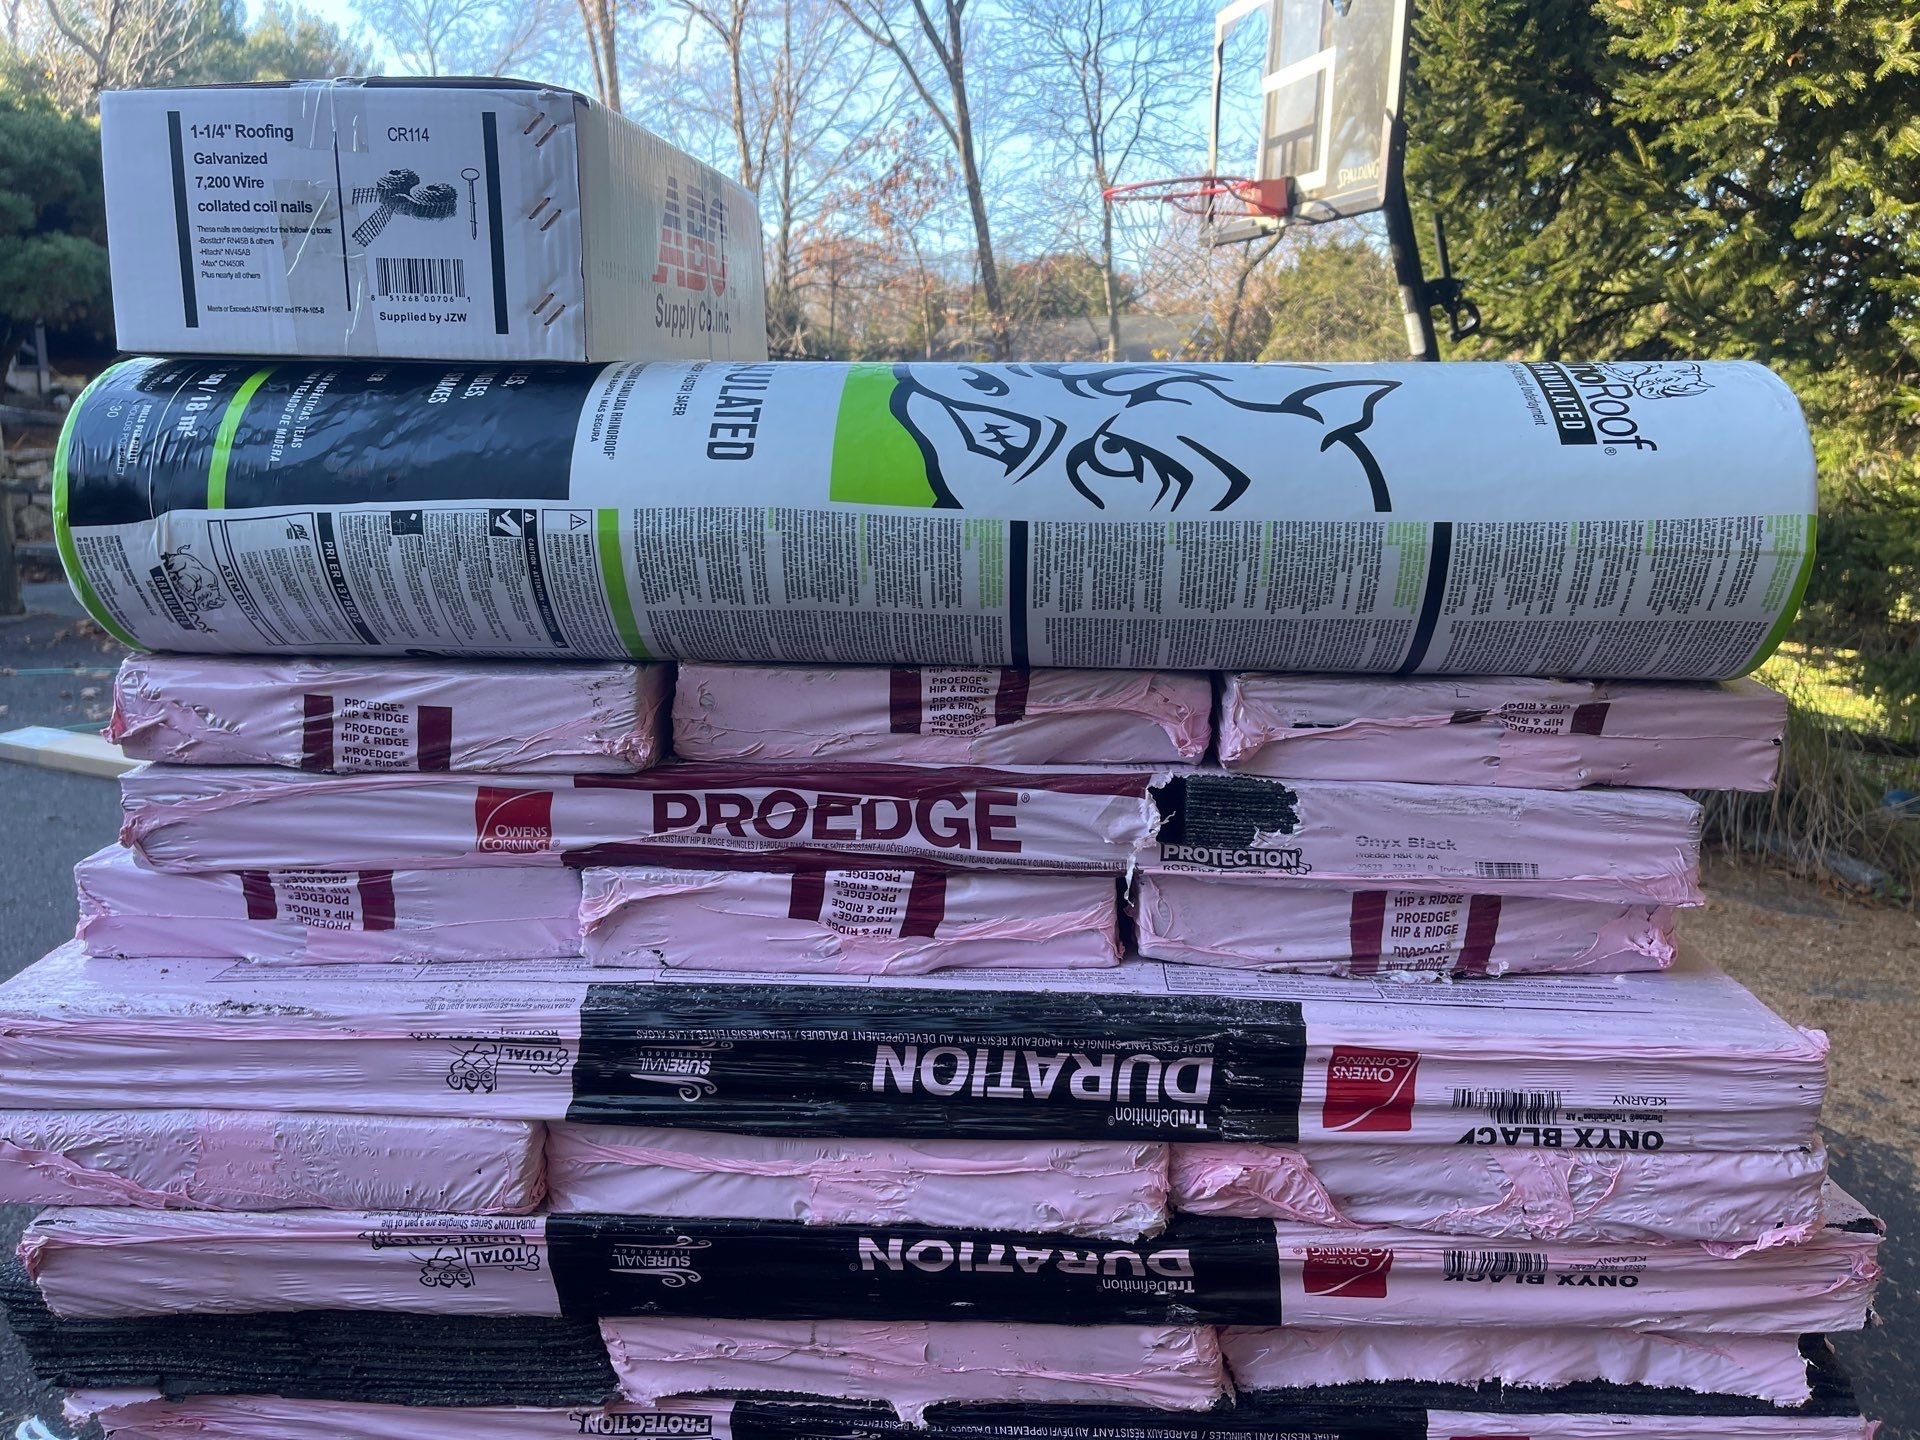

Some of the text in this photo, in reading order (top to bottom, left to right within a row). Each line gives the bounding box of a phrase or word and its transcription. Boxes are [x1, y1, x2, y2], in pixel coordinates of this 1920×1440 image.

[191, 124, 293, 141] 1-1/4" Roofing
[388, 127, 429, 142] CR114
[194, 152, 267, 164] Galvanized
[1338, 158, 1380, 189] SPALDING
[196, 176, 264, 190] 7,200 Wire
[198, 200, 313, 213] collated coil nails
[242, 226, 269, 234] designed
[652, 176, 728, 297] ABC
[380, 312, 467, 324] Supplied by JZW
[656, 293, 696, 338] Supply
[681, 374, 699, 392] FASTER
[186, 395, 212, 411] 18
[672, 395, 690, 416] SAFER
[1522, 386, 1548, 426] Underlayment
[106, 405, 122, 418] 30
[706, 362, 778, 460] NULATED
[118, 404, 140, 449] ROLLOS POR
[132, 404, 152, 438] ROLLS PER
[269, 385, 310, 463] TEJADOS DE MADERA
[591, 399, 609, 443] MÁS SEGURA
[291, 425, 306, 448] TEJAS
[528, 538, 544, 601] CAUTION ATTENTION
[324, 541, 361, 624] PRI ER 1378E02
[154, 575, 190, 625] GRANULATED
[221, 564, 259, 621] ASTM D1970
[960, 686, 990, 694] RIDGE
[340, 709, 358, 718] HIP
[374, 712, 409, 723] RIDGE
[341, 733, 409, 746] HIP & RIDGE
[342, 755, 360, 764] HIP
[495, 824, 548, 838] OWENS
[481, 837, 547, 850] CORNING
[658, 835, 689, 844] RESISTANT
[691, 836, 700, 844] HIP
[701, 837, 706, 845] &
[707, 836, 725, 846] RIDGE
[726, 838, 754, 849] SHINGLES
[759, 841, 790, 850] BARDEAUX
[886, 843, 937, 857] DÉVELOPPEMENT
[937, 850, 964, 862] D'ALGUES
[968, 855, 985, 864] TEJAS
[995, 857, 1026, 866] CABALLETE
[1355, 835, 1458, 851] Onyx Black
[1164, 845, 1296, 867] PROTECTION
[833, 880, 867, 890] RIDGE
[832, 898, 897, 915] HIP & RIDGE
[1394, 895, 1464, 907] HIP & RIDGE
[285, 904, 354, 920] HIP & RIDGE
[826, 918, 858, 935] RIDGE
[1391, 924, 1459, 938] HIP & RIDGE
[637, 1030, 953, 1044] AU DÉVELOPPEMENT D'ALGUES ALGAS
[506, 1048, 553, 1062] TOTAL
[1336, 1056, 1411, 1067] CORNING
[638, 1058, 711, 1074] SURENAIL
[1333, 1066, 1394, 1082] OWENS
[1613, 1095, 1667, 1106] KEARNY
[1566, 1112, 1576, 1121] AR
[1573, 1128, 1664, 1150] ONYX
[382, 1220, 391, 1228] the
[395, 1219, 402, 1228] of
[405, 1217, 419, 1227] part
[438, 1219, 468, 1229] Shingles
[469, 1219, 493, 1229] Series
[471, 1247, 524, 1262] TOTAL
[612, 1255, 690, 1266] SURENAIL
[1594, 1256, 1647, 1264] KEARNY
[1445, 1271, 1639, 1288] ONYX BLACK
[585, 1415, 709, 1434] PROTECTION
[1075, 1427, 1197, 1440] BARDEAUX AU
